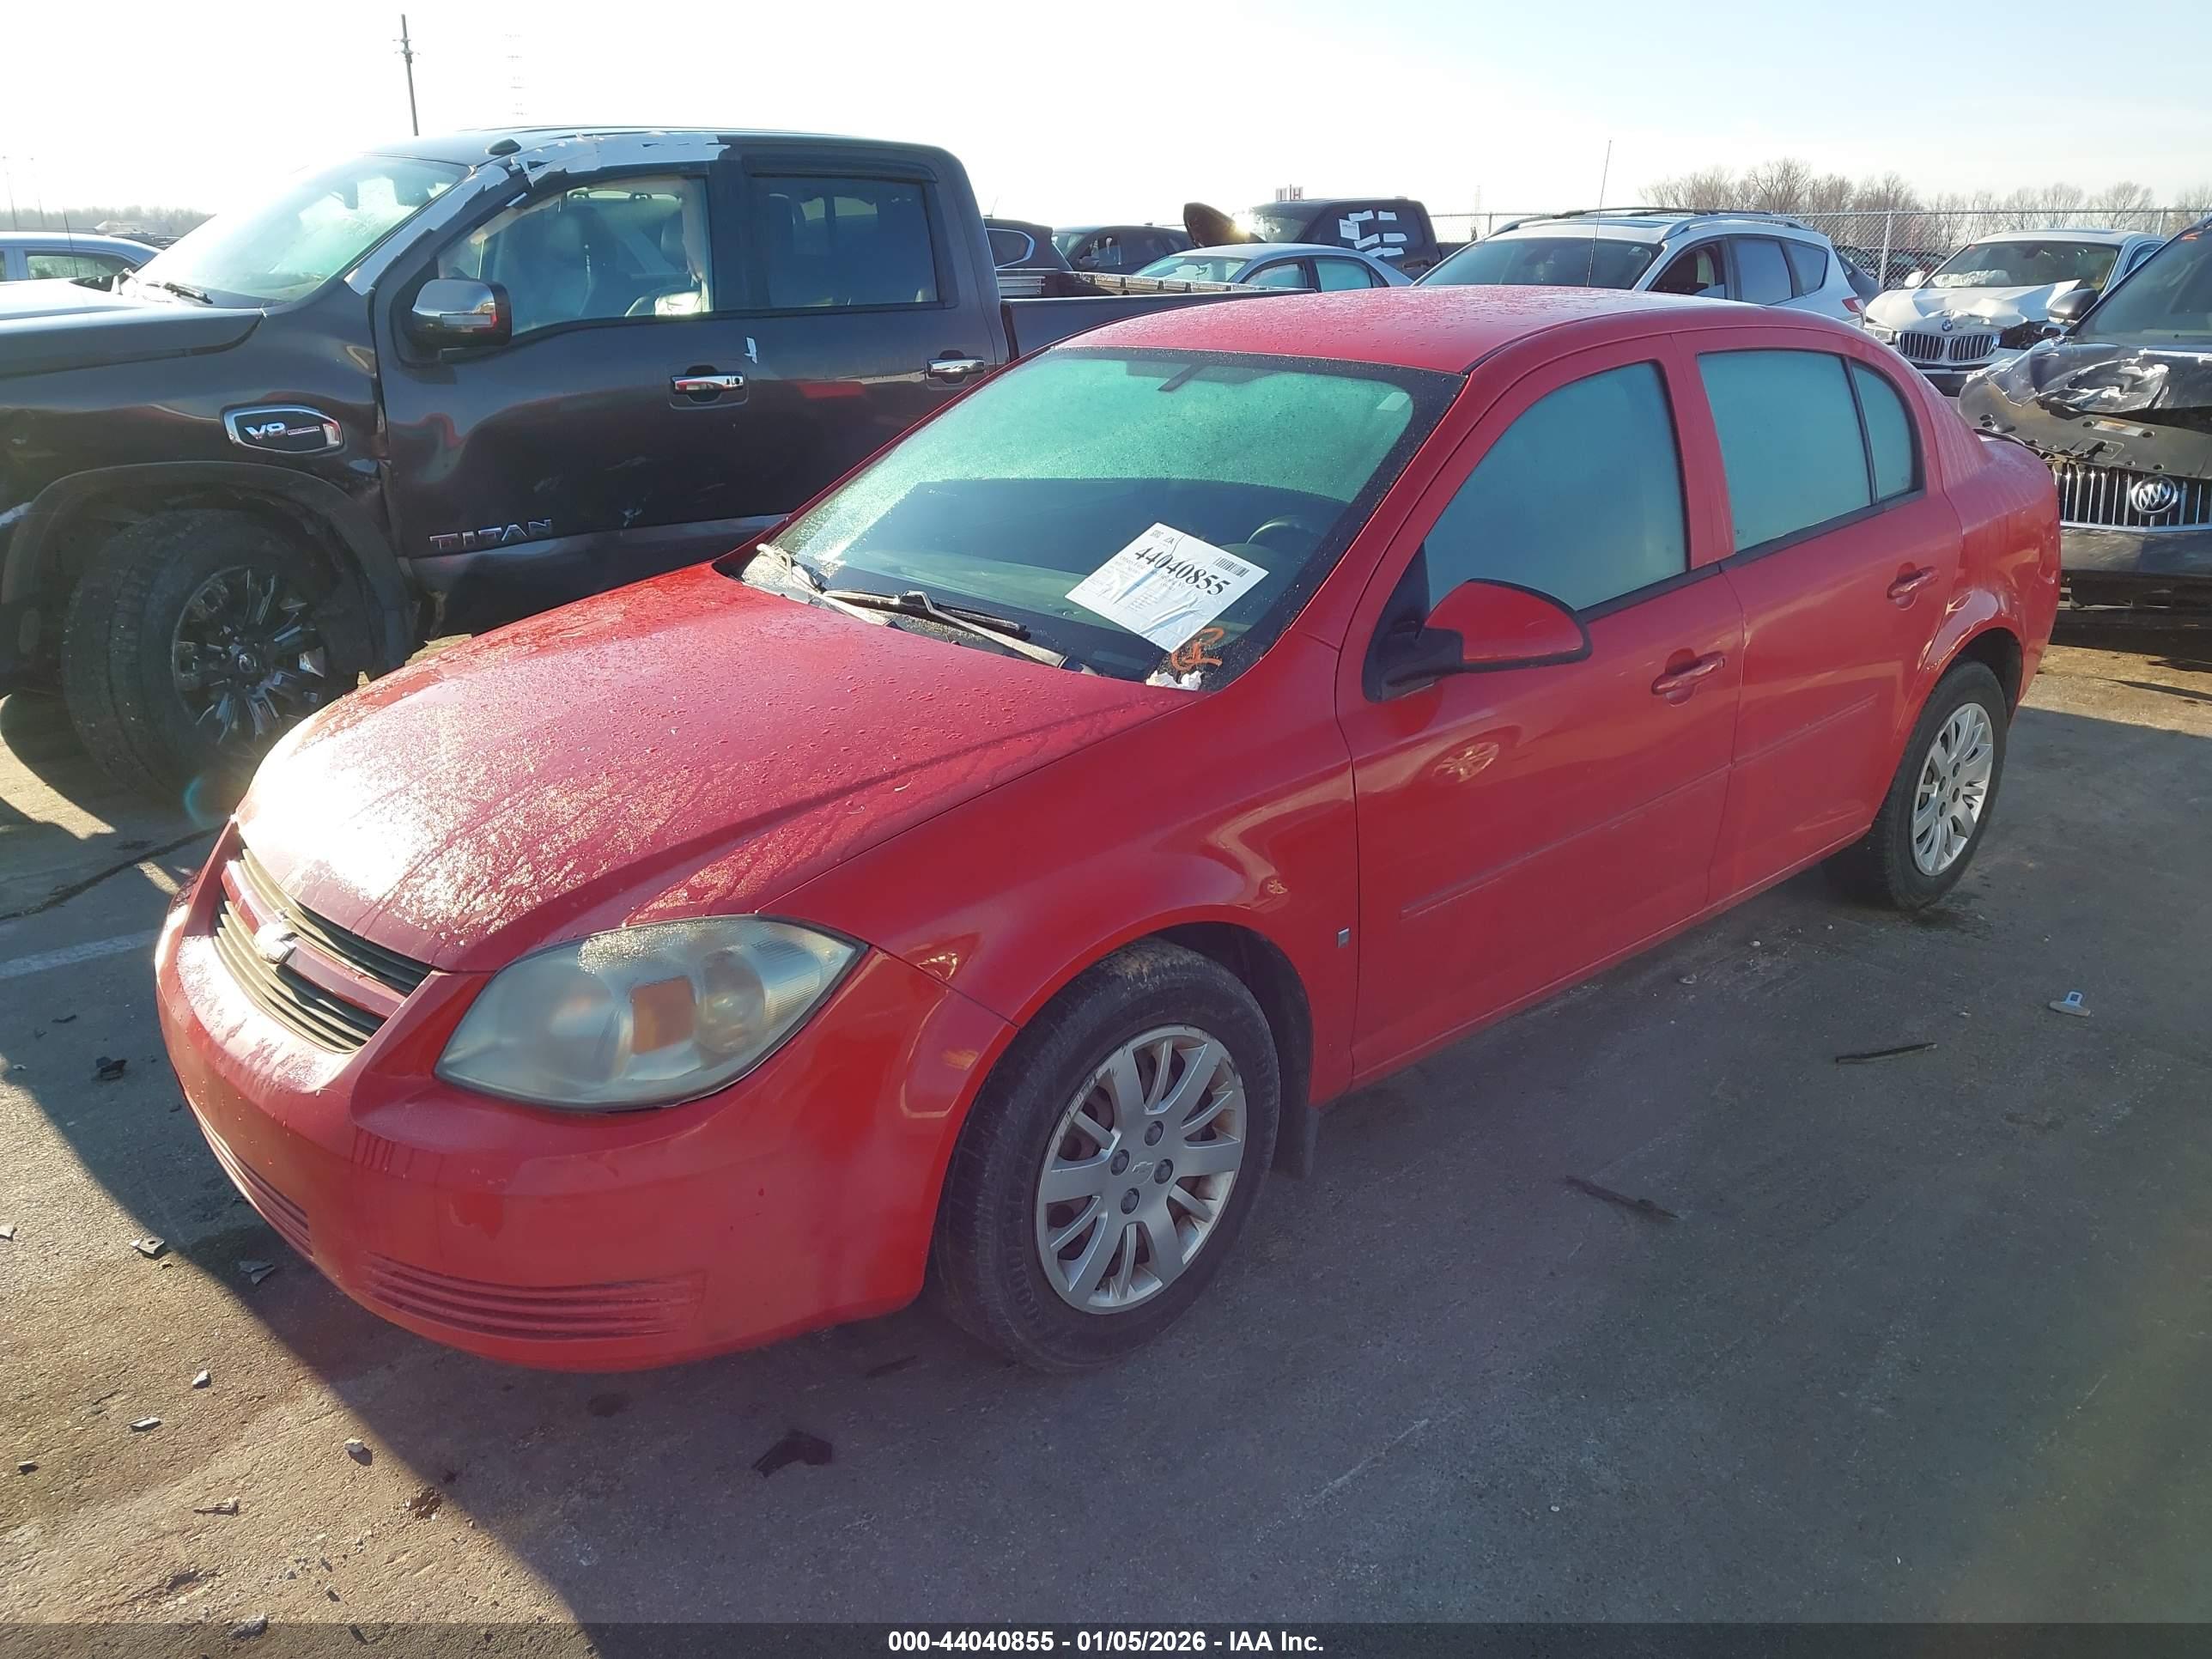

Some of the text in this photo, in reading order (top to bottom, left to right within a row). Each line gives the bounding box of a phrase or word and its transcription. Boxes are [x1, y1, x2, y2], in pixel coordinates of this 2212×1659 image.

[245, 422, 286, 440] V8
[429, 519, 552, 550] TITAN
[1134, 547, 1231, 595] 44040855
